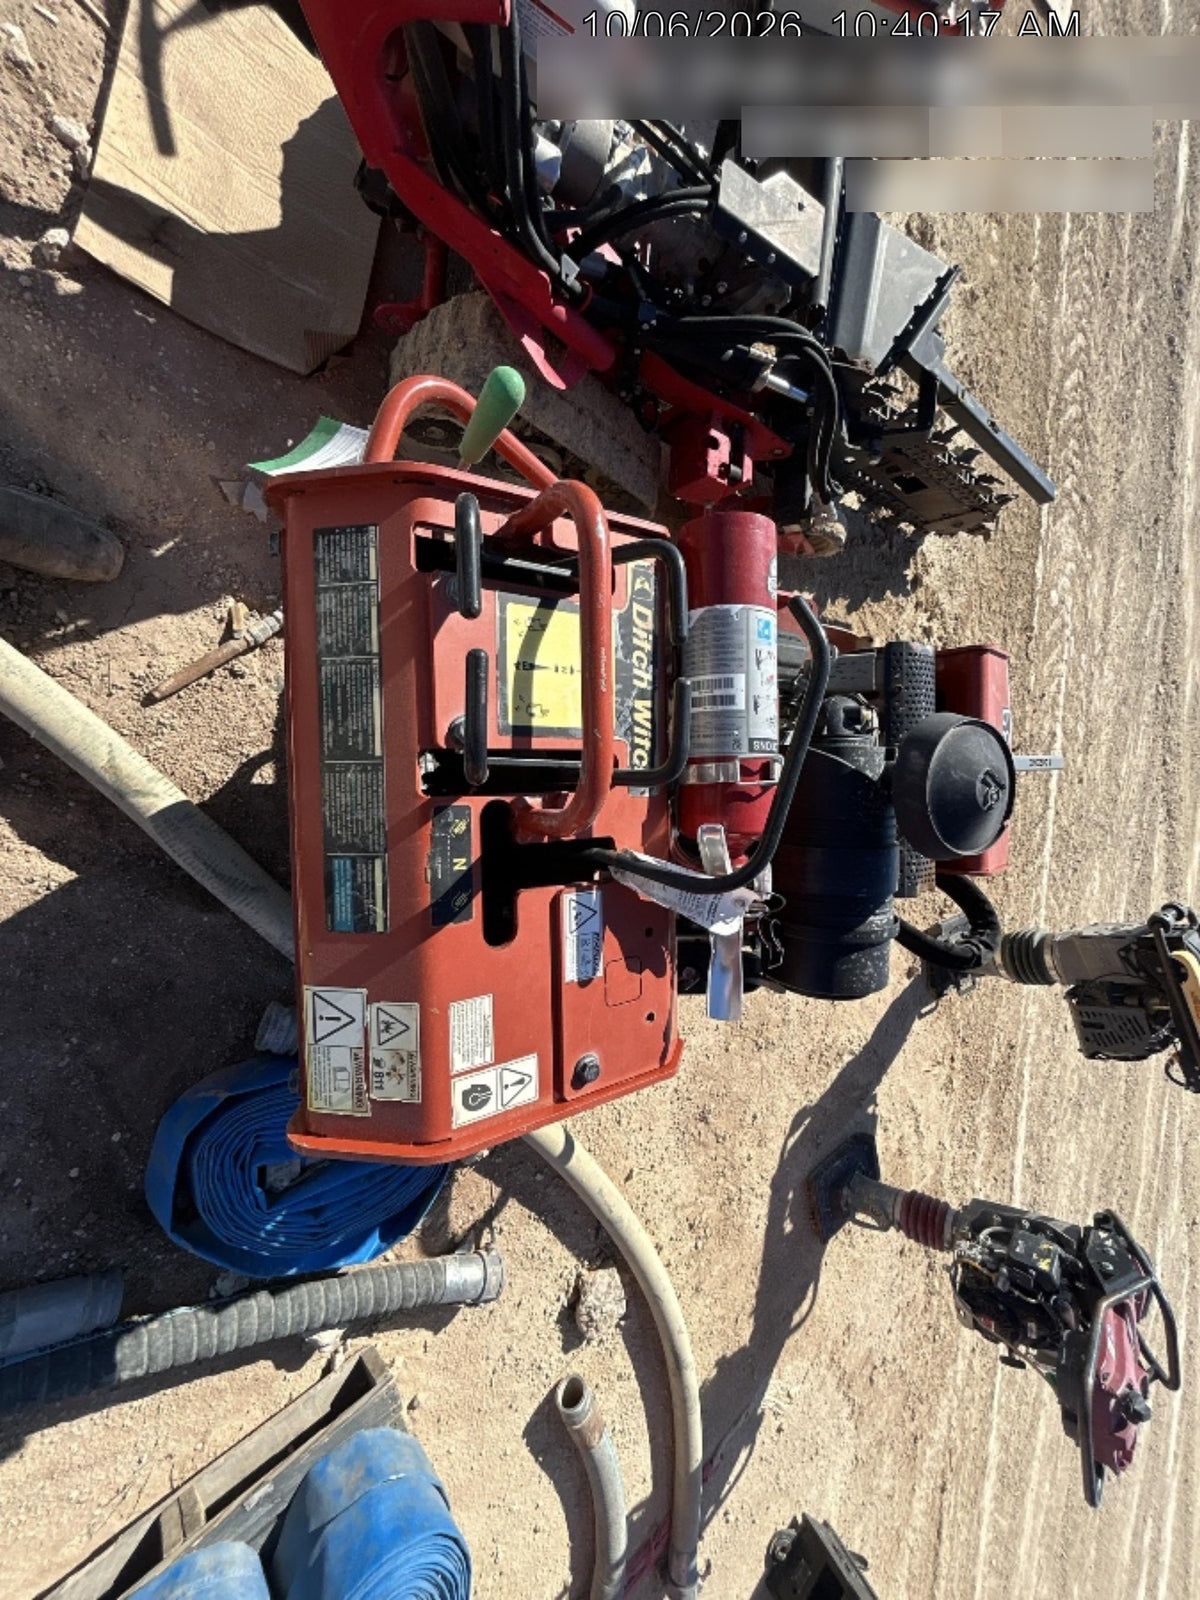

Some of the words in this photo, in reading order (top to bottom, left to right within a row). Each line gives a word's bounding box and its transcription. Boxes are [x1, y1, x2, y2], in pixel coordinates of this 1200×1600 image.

[632, 602, 654, 689] Ditch
[632, 700, 652, 770] Witc
[453, 857, 468, 871] N
[374, 1071, 385, 1091] 811
